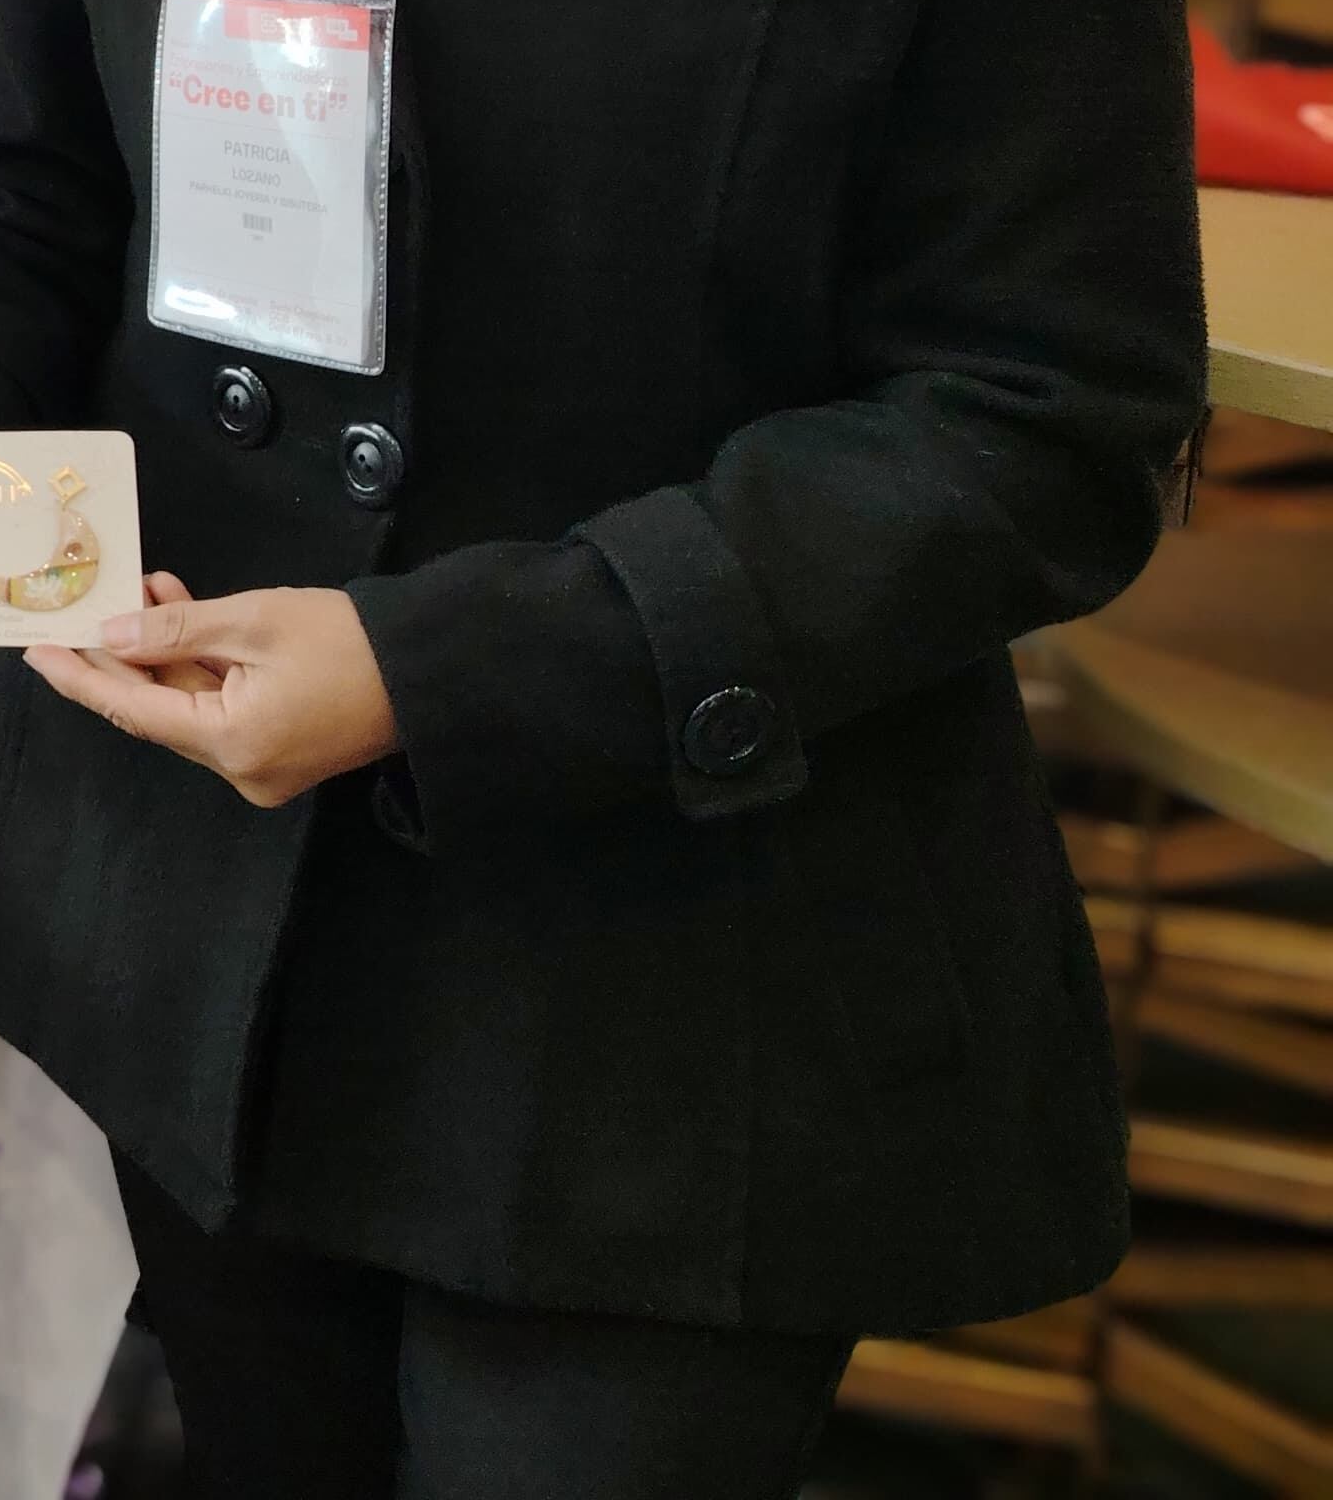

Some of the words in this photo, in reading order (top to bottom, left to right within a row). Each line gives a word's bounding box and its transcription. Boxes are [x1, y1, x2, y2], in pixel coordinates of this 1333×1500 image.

[257, 91, 295, 117] en
[224, 140, 291, 164] PATRICIA
[231, 167, 281, 188] LOZANO
